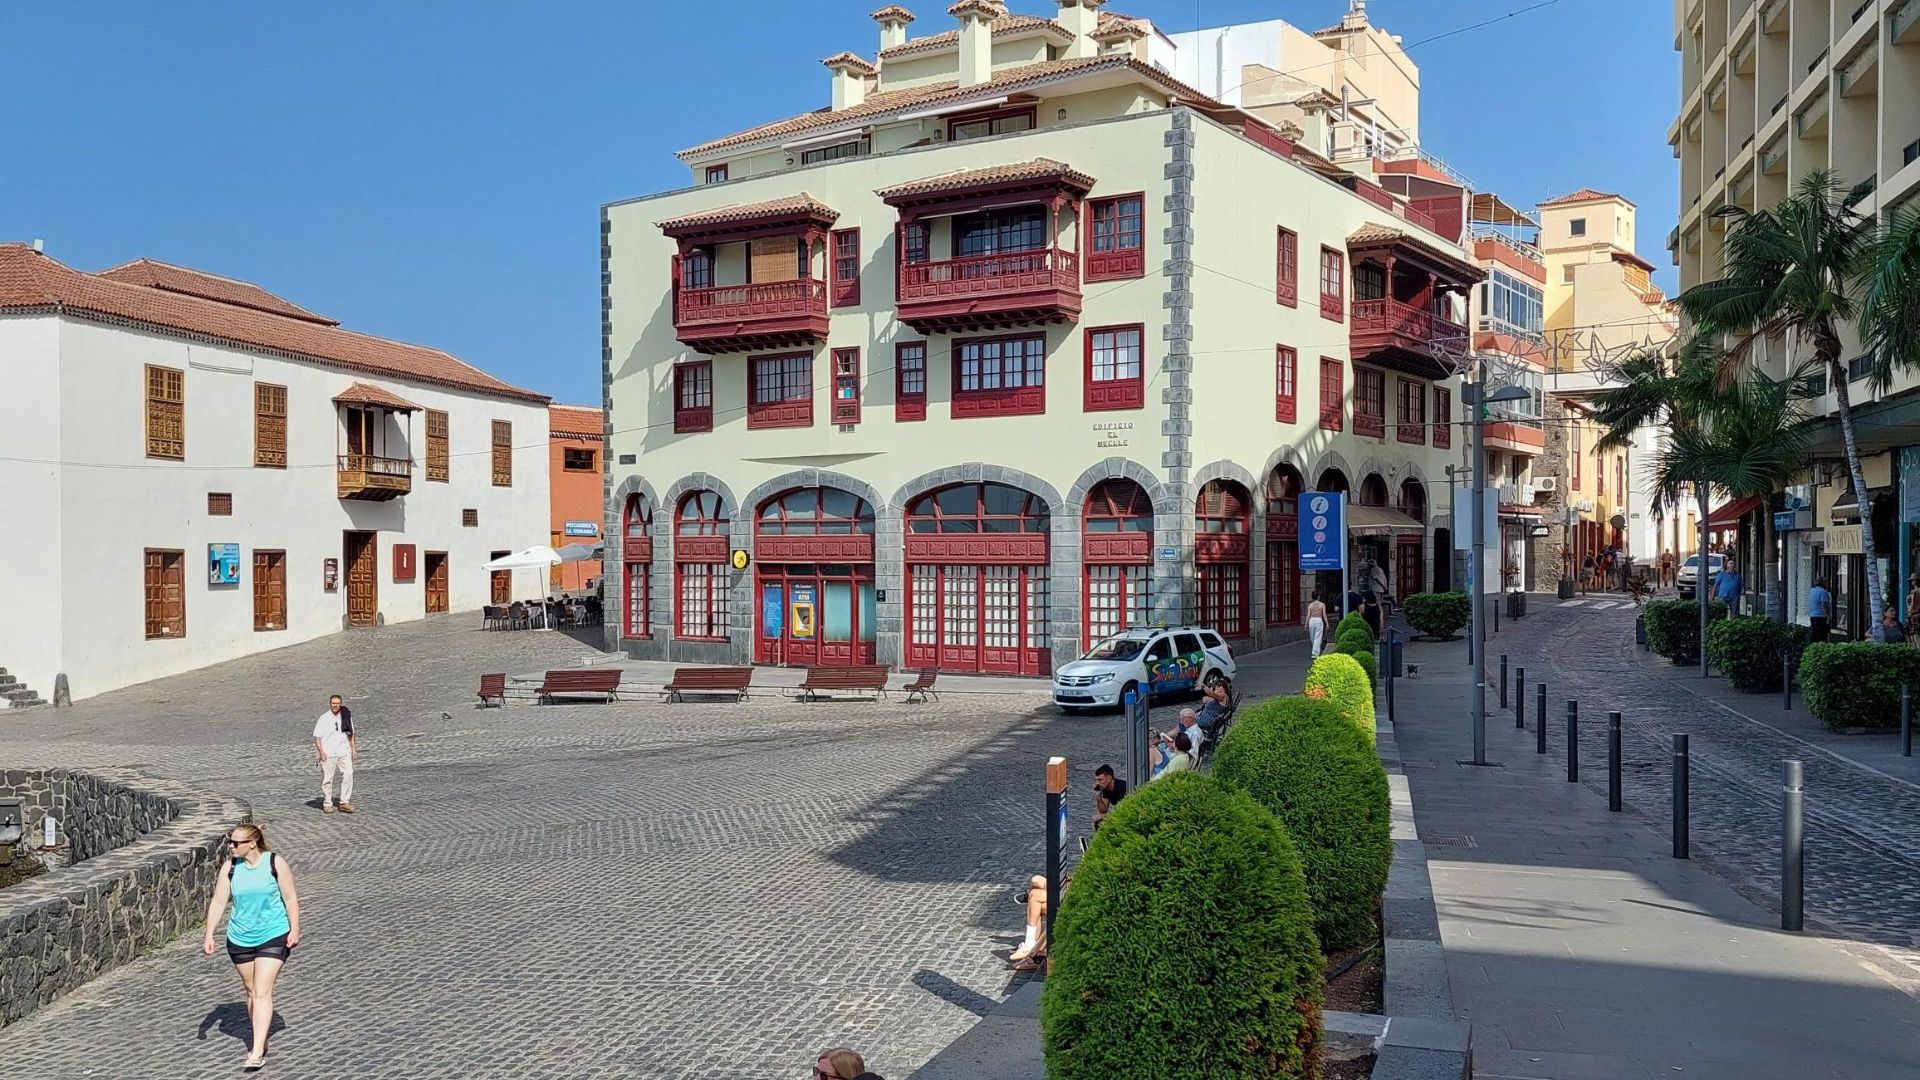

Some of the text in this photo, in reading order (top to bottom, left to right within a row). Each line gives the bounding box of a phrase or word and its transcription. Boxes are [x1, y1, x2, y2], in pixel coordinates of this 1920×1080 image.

[1092, 422, 1134, 431] EDIFICIO
[1106, 431, 1119, 439] EL
[1096, 440, 1129, 448] MUELLE
